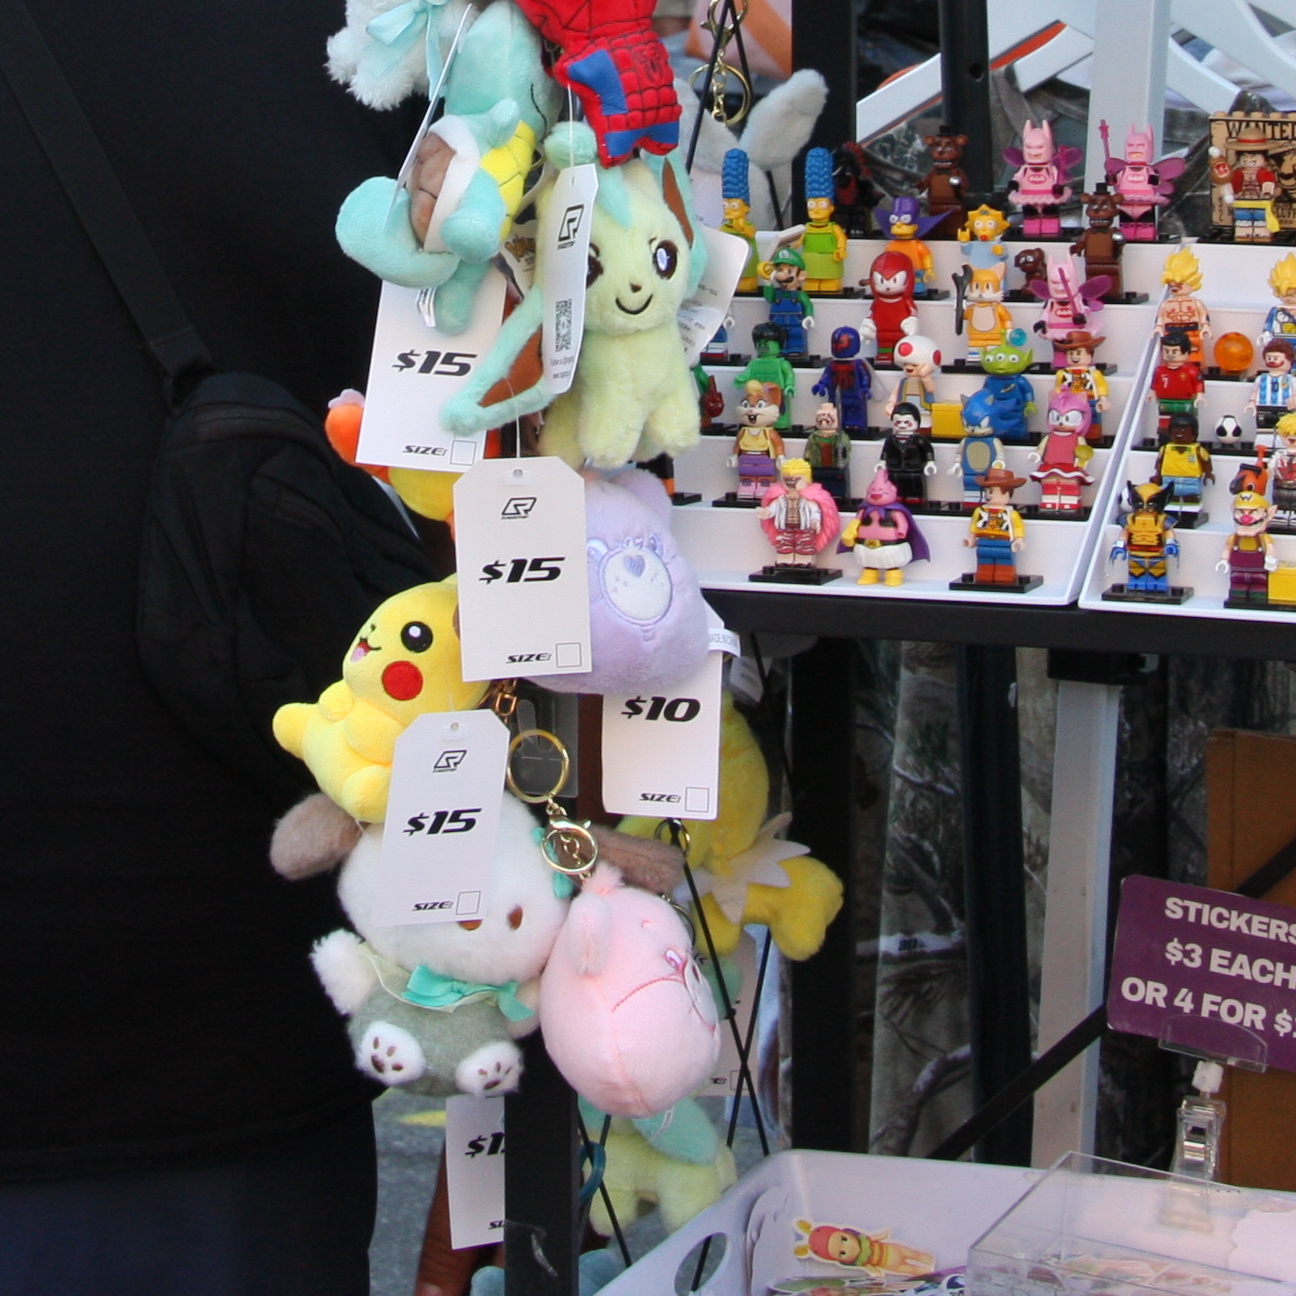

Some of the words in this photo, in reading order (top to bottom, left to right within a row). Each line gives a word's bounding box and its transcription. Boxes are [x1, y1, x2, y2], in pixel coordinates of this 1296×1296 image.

[391, 349, 478, 376] $15
[1162, 377, 1169, 388] 7
[478, 557, 566, 585] $15
[621, 695, 701, 722] $10
[402, 808, 483, 836] $15
[1165, 938, 1202, 969] $3
[1121, 977, 1168, 1008] OR
[1174, 988, 1194, 1013] 4
[1201, 993, 1266, 1031] FOR
[465, 1131, 505, 1158] $1
